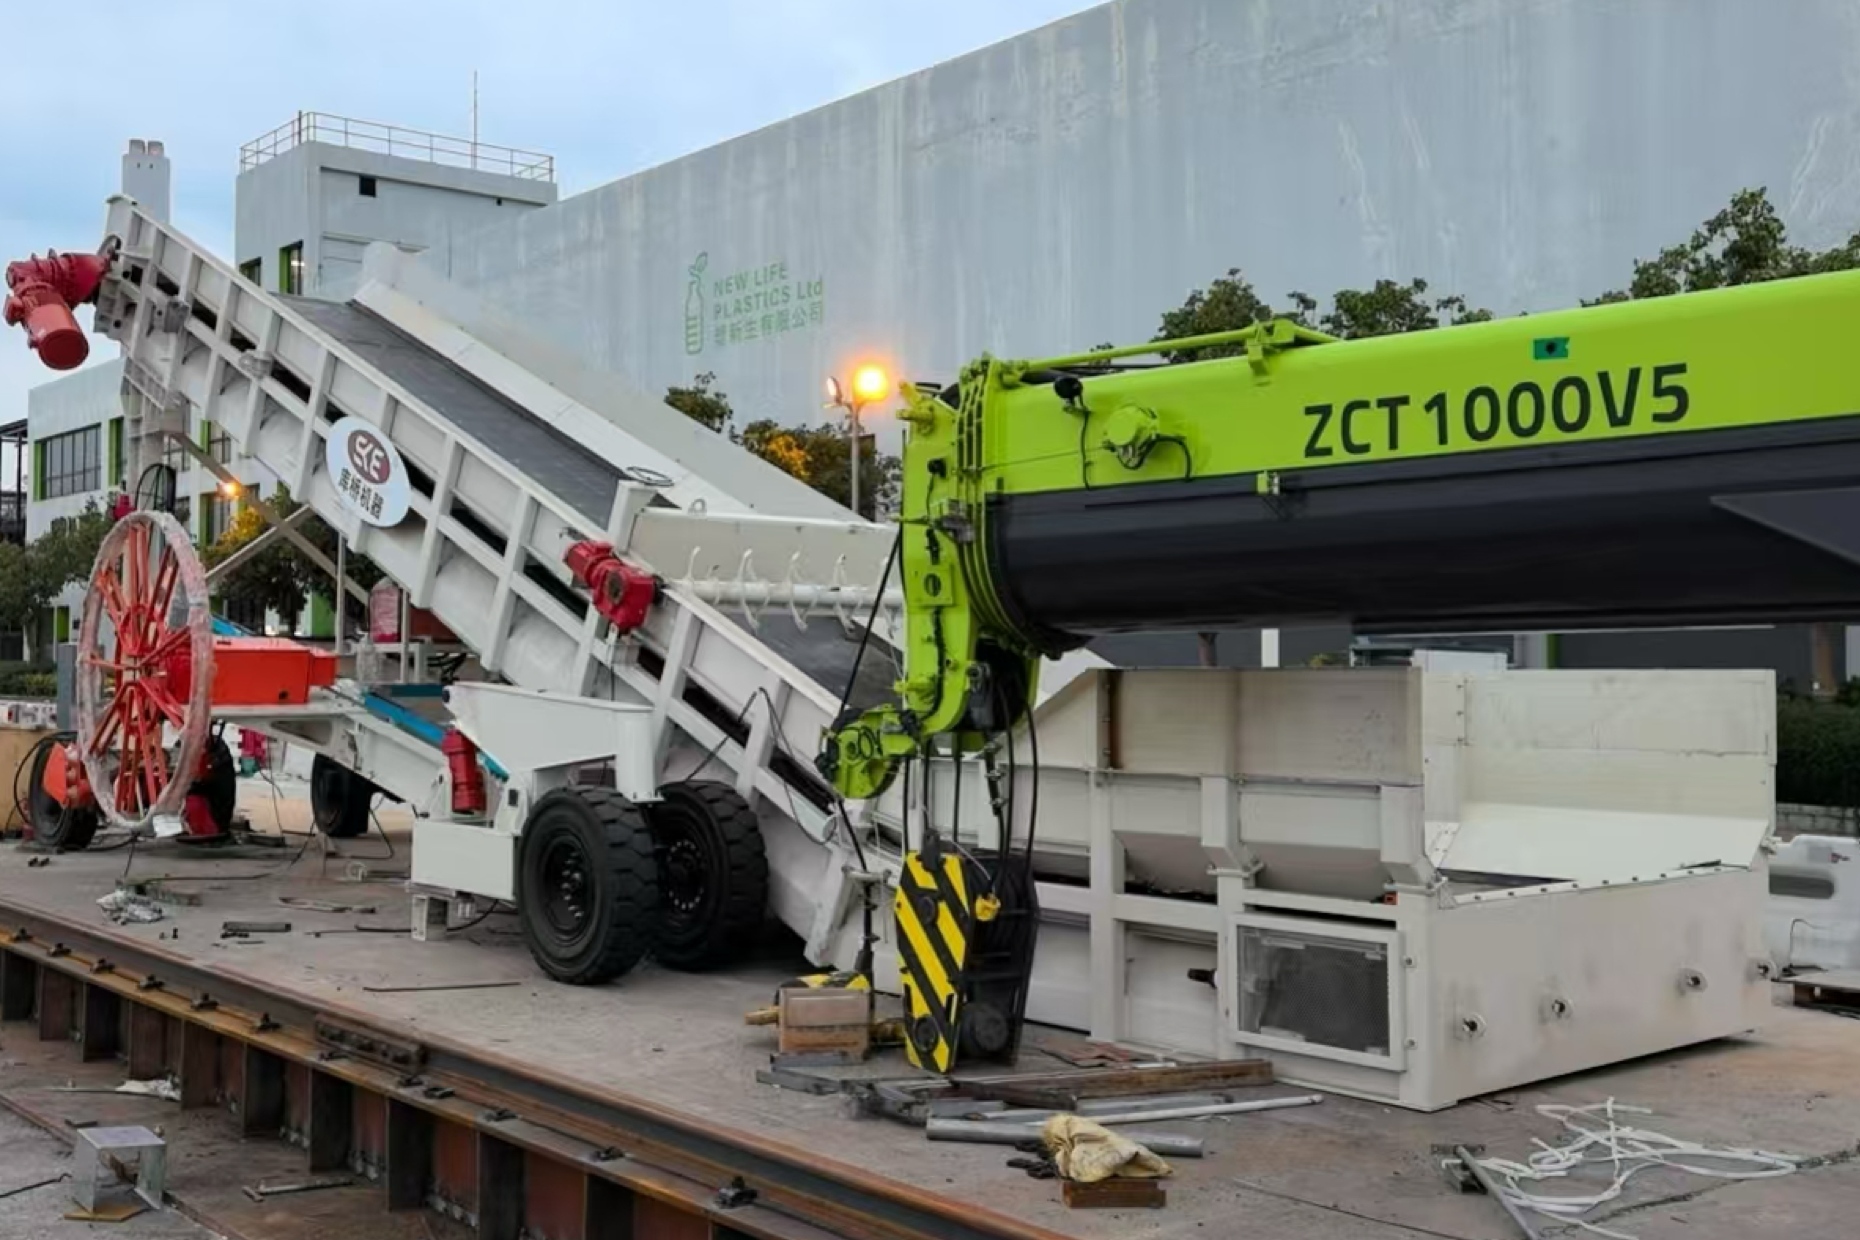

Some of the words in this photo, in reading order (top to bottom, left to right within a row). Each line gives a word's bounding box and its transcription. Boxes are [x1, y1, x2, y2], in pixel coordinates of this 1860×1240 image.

[714, 272, 748, 297] NEW
[754, 262, 787, 287] LIFE
[714, 285, 790, 320] PLASTICS
[797, 275, 822, 300] Ltd
